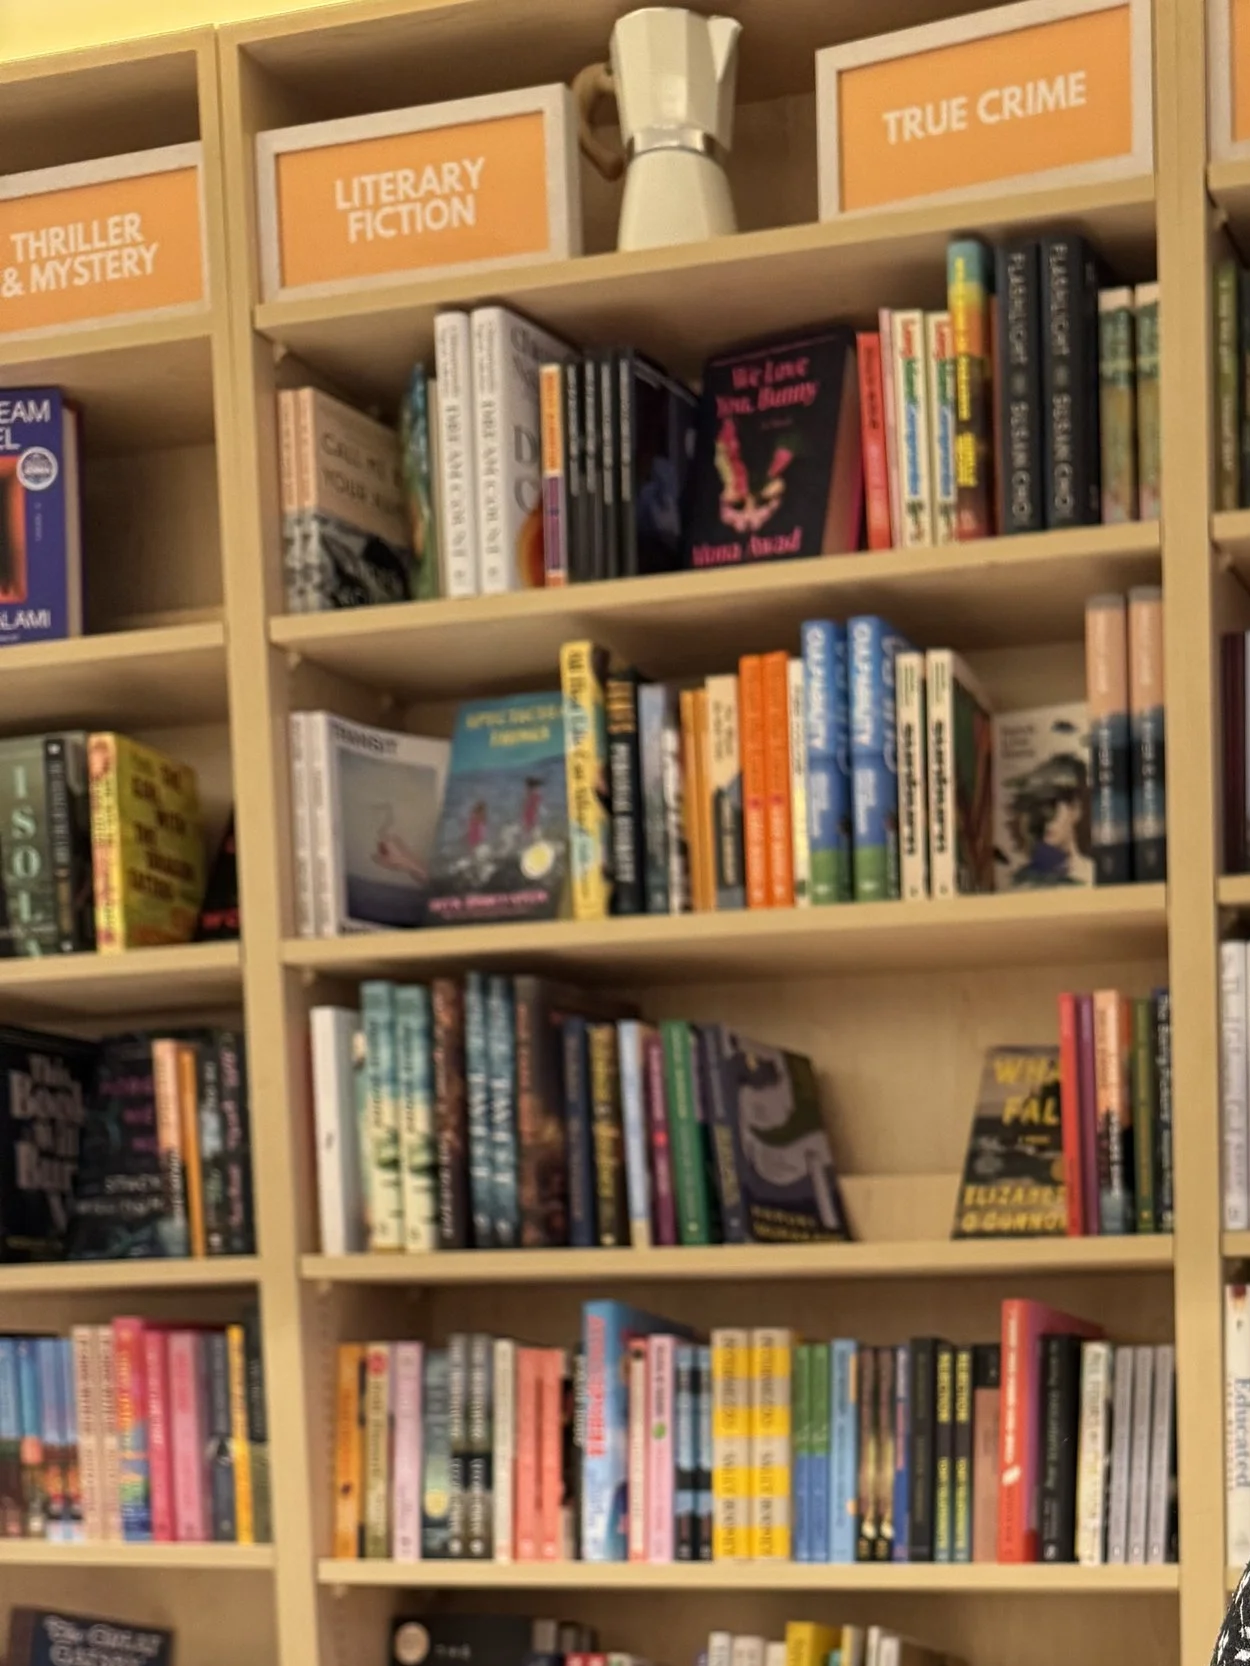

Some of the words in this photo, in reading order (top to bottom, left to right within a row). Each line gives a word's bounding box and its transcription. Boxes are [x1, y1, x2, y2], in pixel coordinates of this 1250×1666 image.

[882, 96, 968, 146] TRUE
[976, 71, 1088, 125] CRIME
[334, 156, 487, 212] LITERARY
[10, 213, 145, 262] THRILLER
[347, 196, 477, 244] FICTION
[1, 267, 25, 298] &
[30, 243, 160, 294] MYSTERY
[1048, 244, 1071, 357] FLASHLIGHT
[732, 367, 760, 389] We
[764, 357, 810, 384] Love
[757, 381, 820, 411] Bunny
[1051, 392, 1072, 461] SUSAN
[1055, 462, 1075, 518] CHOI
[692, 541, 742, 567] Mona
[749, 525, 802, 557] Awad
[993, 1057, 1061, 1084] WHA
[1001, 1095, 1062, 1126] FAL
